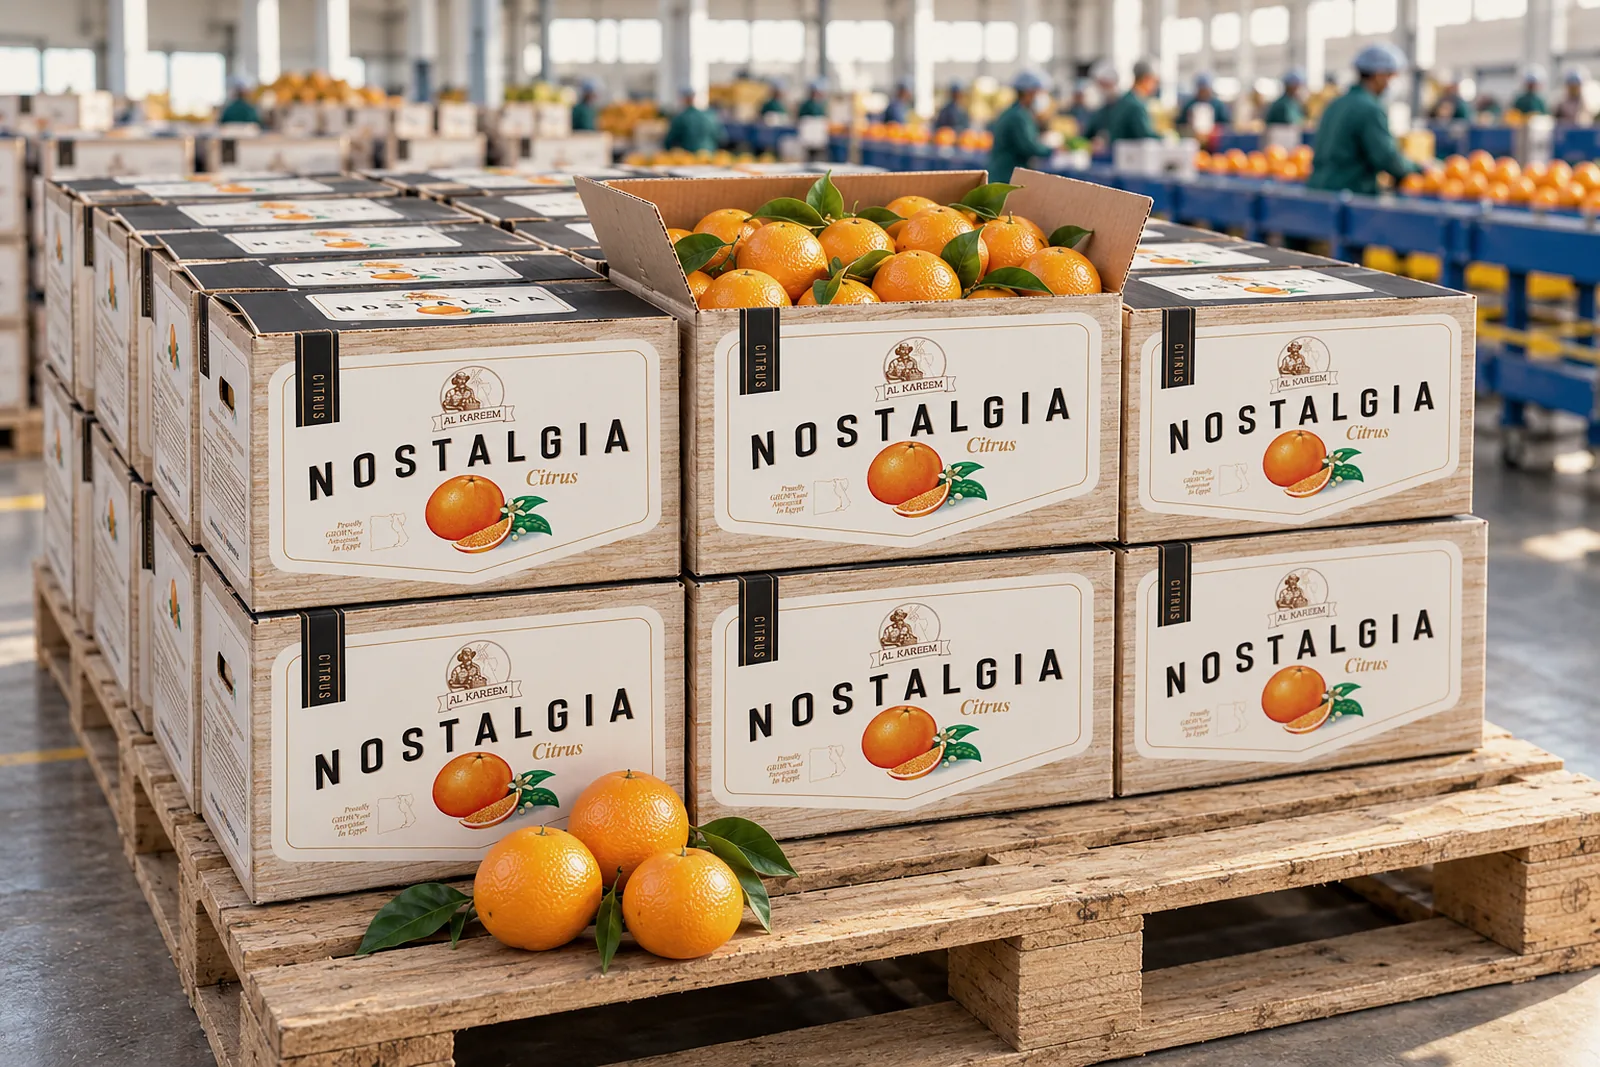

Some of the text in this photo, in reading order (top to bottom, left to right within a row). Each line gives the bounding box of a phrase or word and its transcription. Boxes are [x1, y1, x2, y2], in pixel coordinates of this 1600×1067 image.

[755, 344, 767, 388] CITRUS
[1173, 342, 1184, 383] CITRUS
[886, 380, 943, 395] AL KAREEM
[1292, 374, 1327, 386] KAREEM
[312, 374, 326, 420] CITRUS
[443, 410, 501, 425] AL KAREEM
[751, 387, 1071, 470] NOSTALGIA
[1169, 381, 1434, 454] NOSTALGIA
[966, 436, 1017, 454] Citrus
[1346, 425, 1389, 441] Citrus
[308, 418, 630, 501] NOSTALGIA
[526, 469, 578, 487] Citrus
[1170, 579, 1181, 620] CITRUS
[1277, 606, 1326, 622] AL KAREEM
[753, 616, 766, 659] CITRUS
[881, 644, 938, 661] AL KAREEM
[1166, 609, 1434, 698] NOSTALGIA
[1344, 657, 1388, 674] Citrus
[318, 653, 331, 699] CITRUS
[449, 685, 508, 705] AL KAREEM
[748, 648, 1063, 742] NOSTALGIA
[960, 698, 1011, 716] Citrus
[314, 688, 634, 791] NOSTALGIA
[532, 742, 583, 761] Citrus
